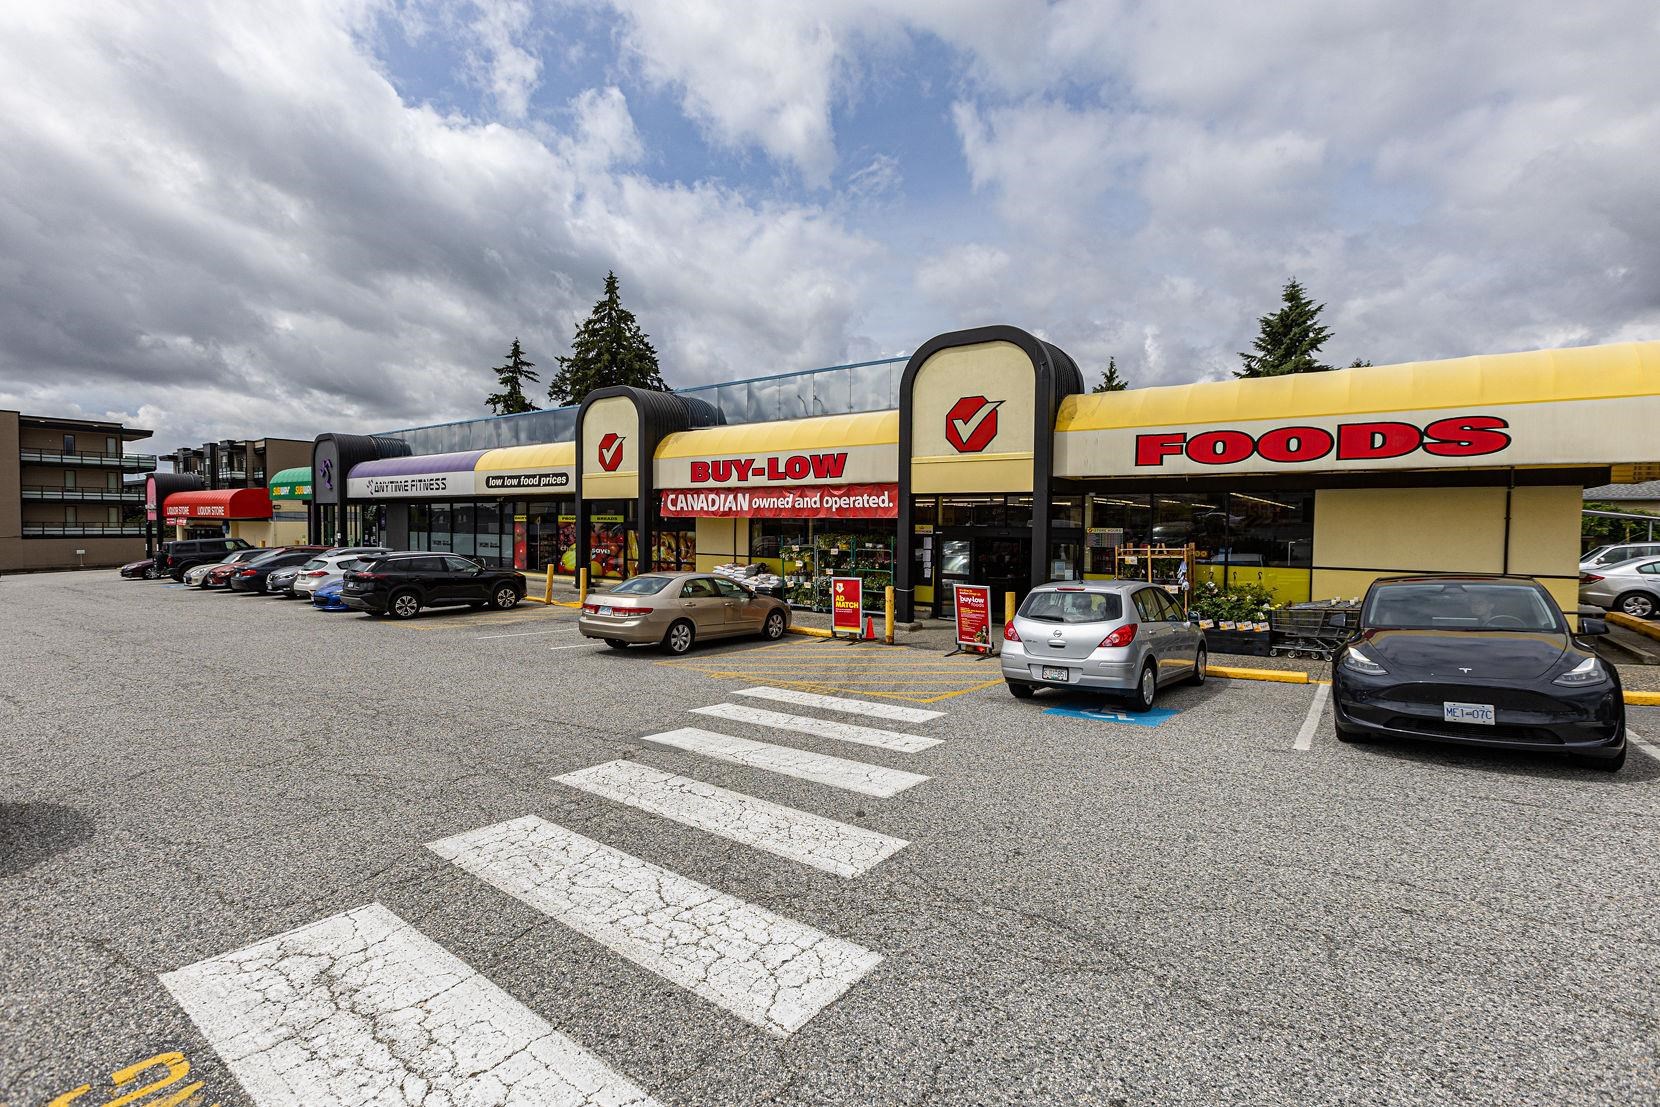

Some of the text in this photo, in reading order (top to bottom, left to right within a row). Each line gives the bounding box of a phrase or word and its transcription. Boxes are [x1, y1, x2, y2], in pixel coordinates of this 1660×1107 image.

[1135, 416, 1511, 466] FOODS
[690, 453, 848, 483] BUY-LOW
[374, 477, 447, 493] ANYTIME FITNESS
[489, 475, 566, 488] low low food prices
[667, 491, 894, 511] CANADIAN owned and operated.
[197, 506, 224, 516] LIQUOR STORE
